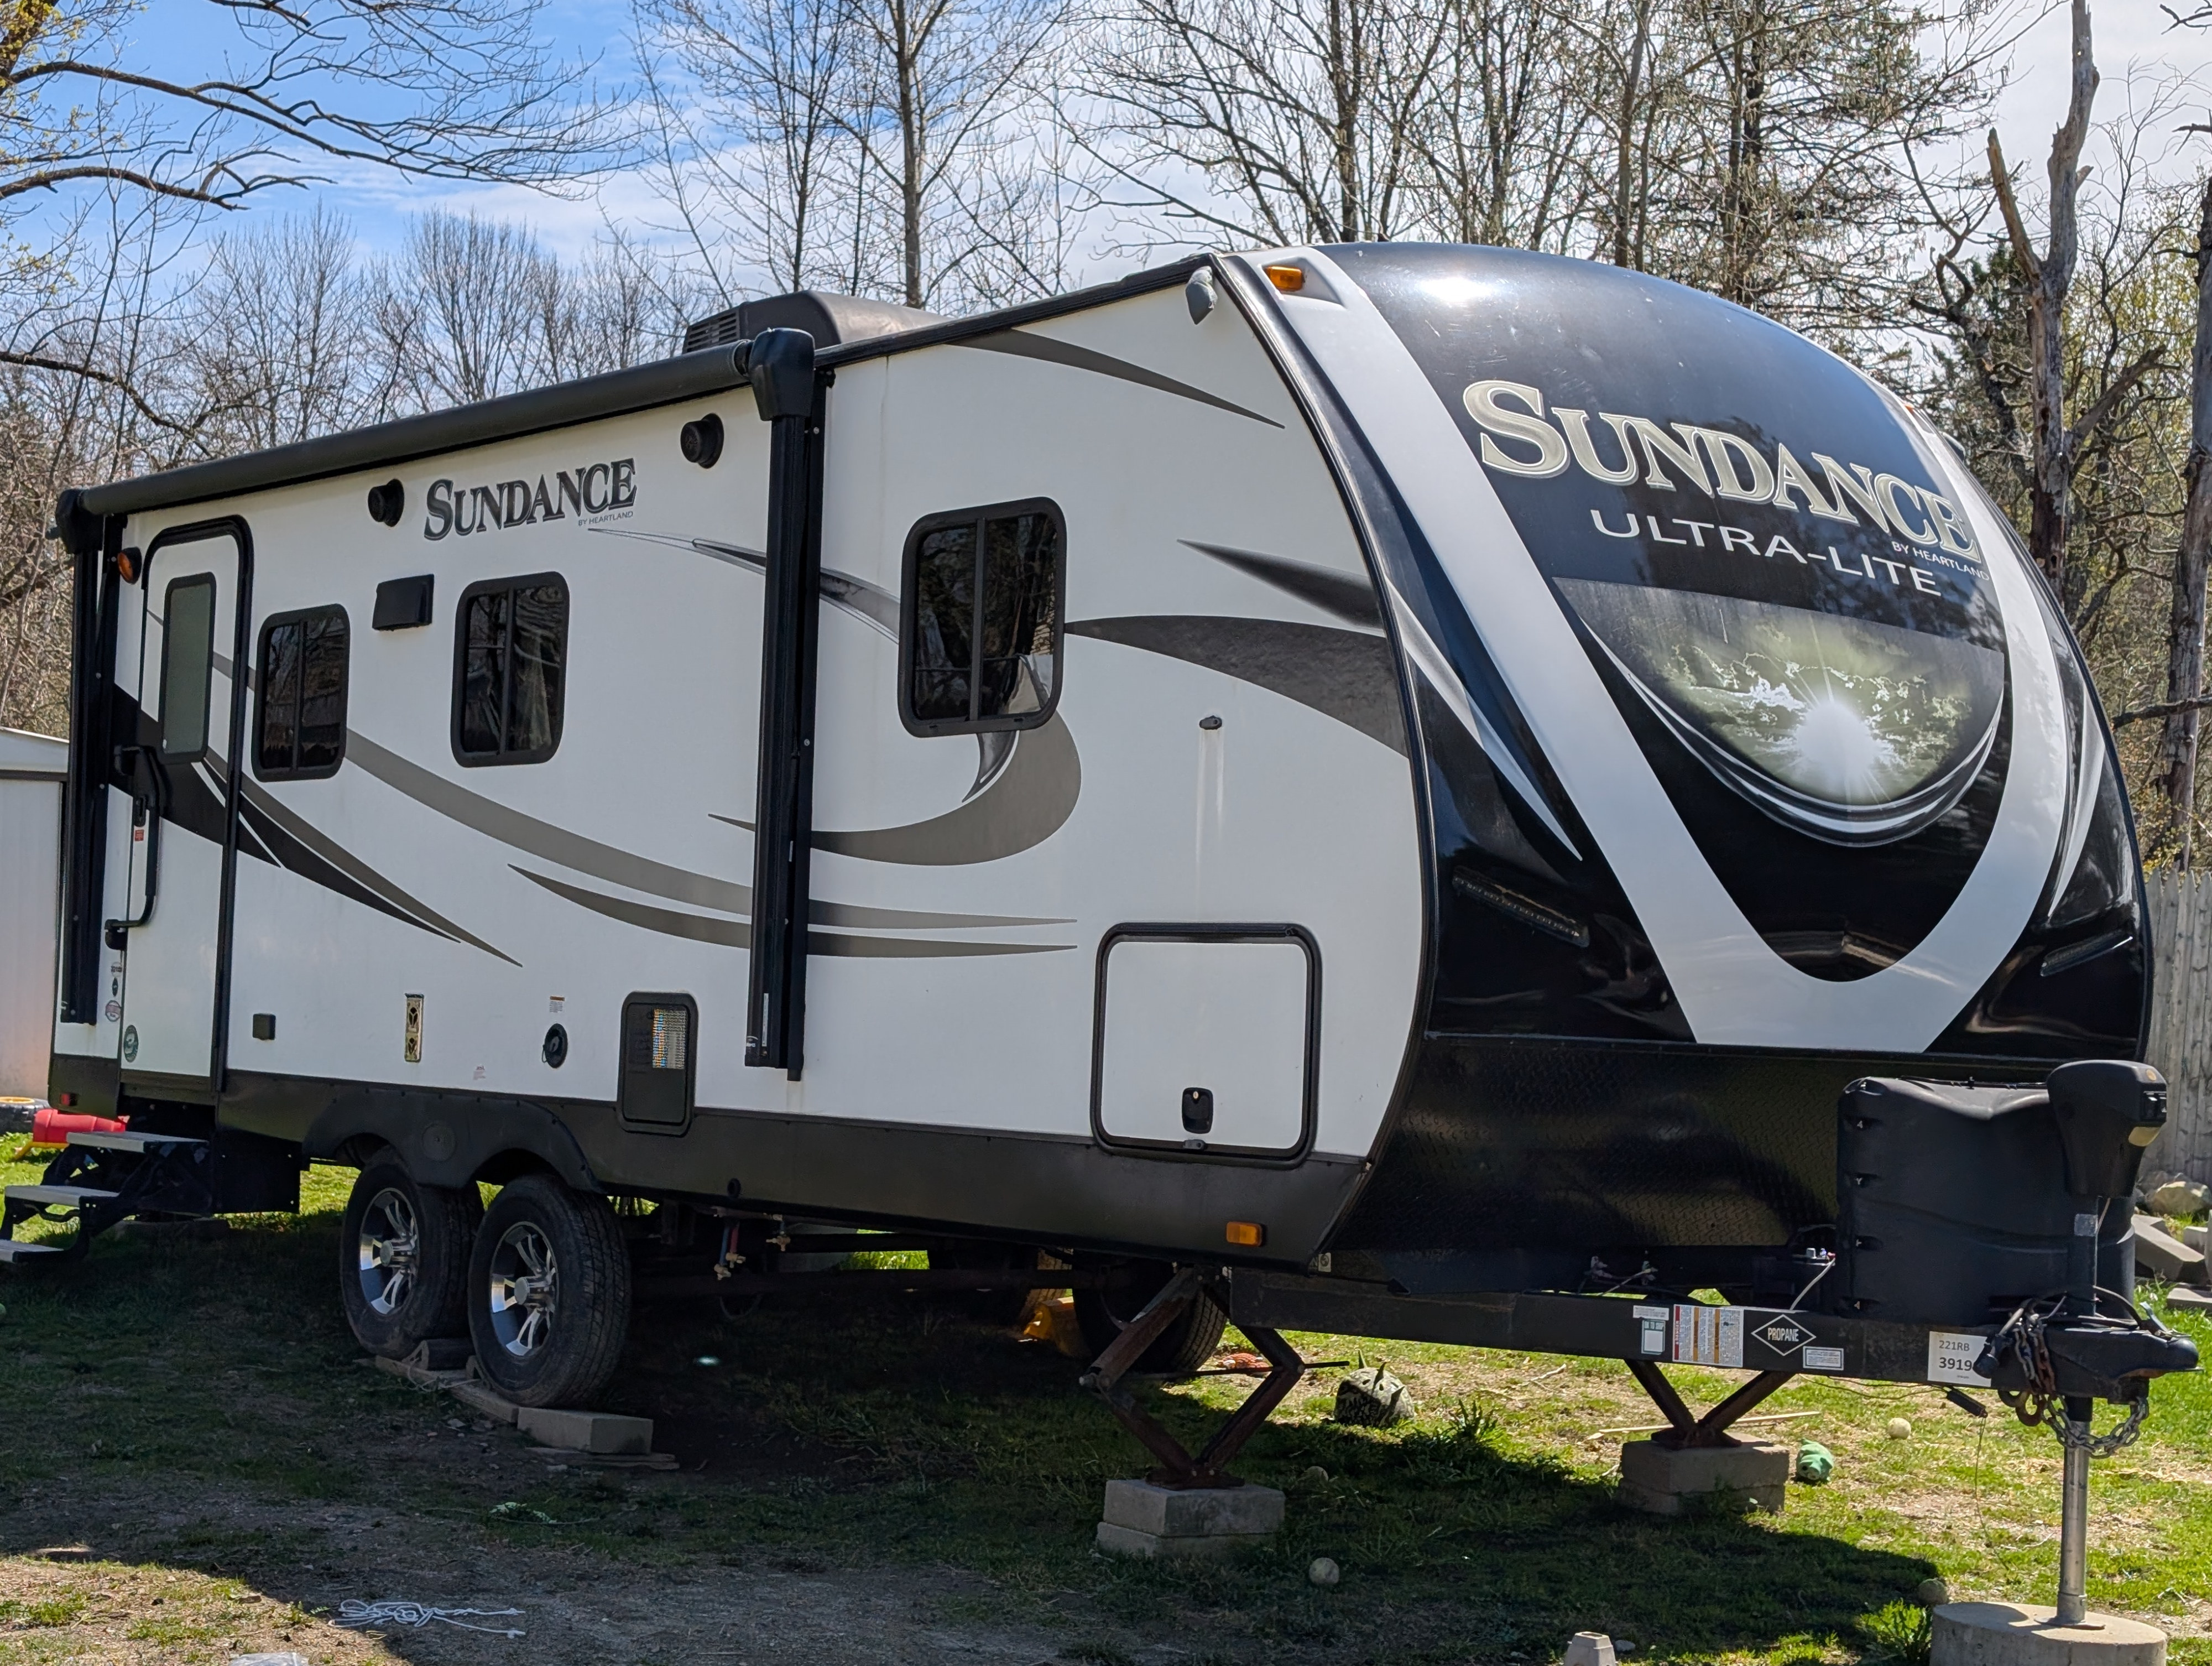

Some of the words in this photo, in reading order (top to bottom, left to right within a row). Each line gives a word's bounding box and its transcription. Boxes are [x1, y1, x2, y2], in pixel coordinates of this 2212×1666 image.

[1462, 379, 1982, 564] SUNDANCE
[424, 458, 637, 541] SUNDANCE
[588, 511, 634, 525] HEARTLAND
[1590, 509, 1942, 597] ULTRA-LITE
[1891, 541, 1909, 555] BY
[1912, 547, 1990, 581] HEARTLAND
[1767, 1327, 1799, 1342] PROPANE
[1939, 1340, 1970, 1351] 221RB
[1939, 1357, 1973, 1371] 3919
